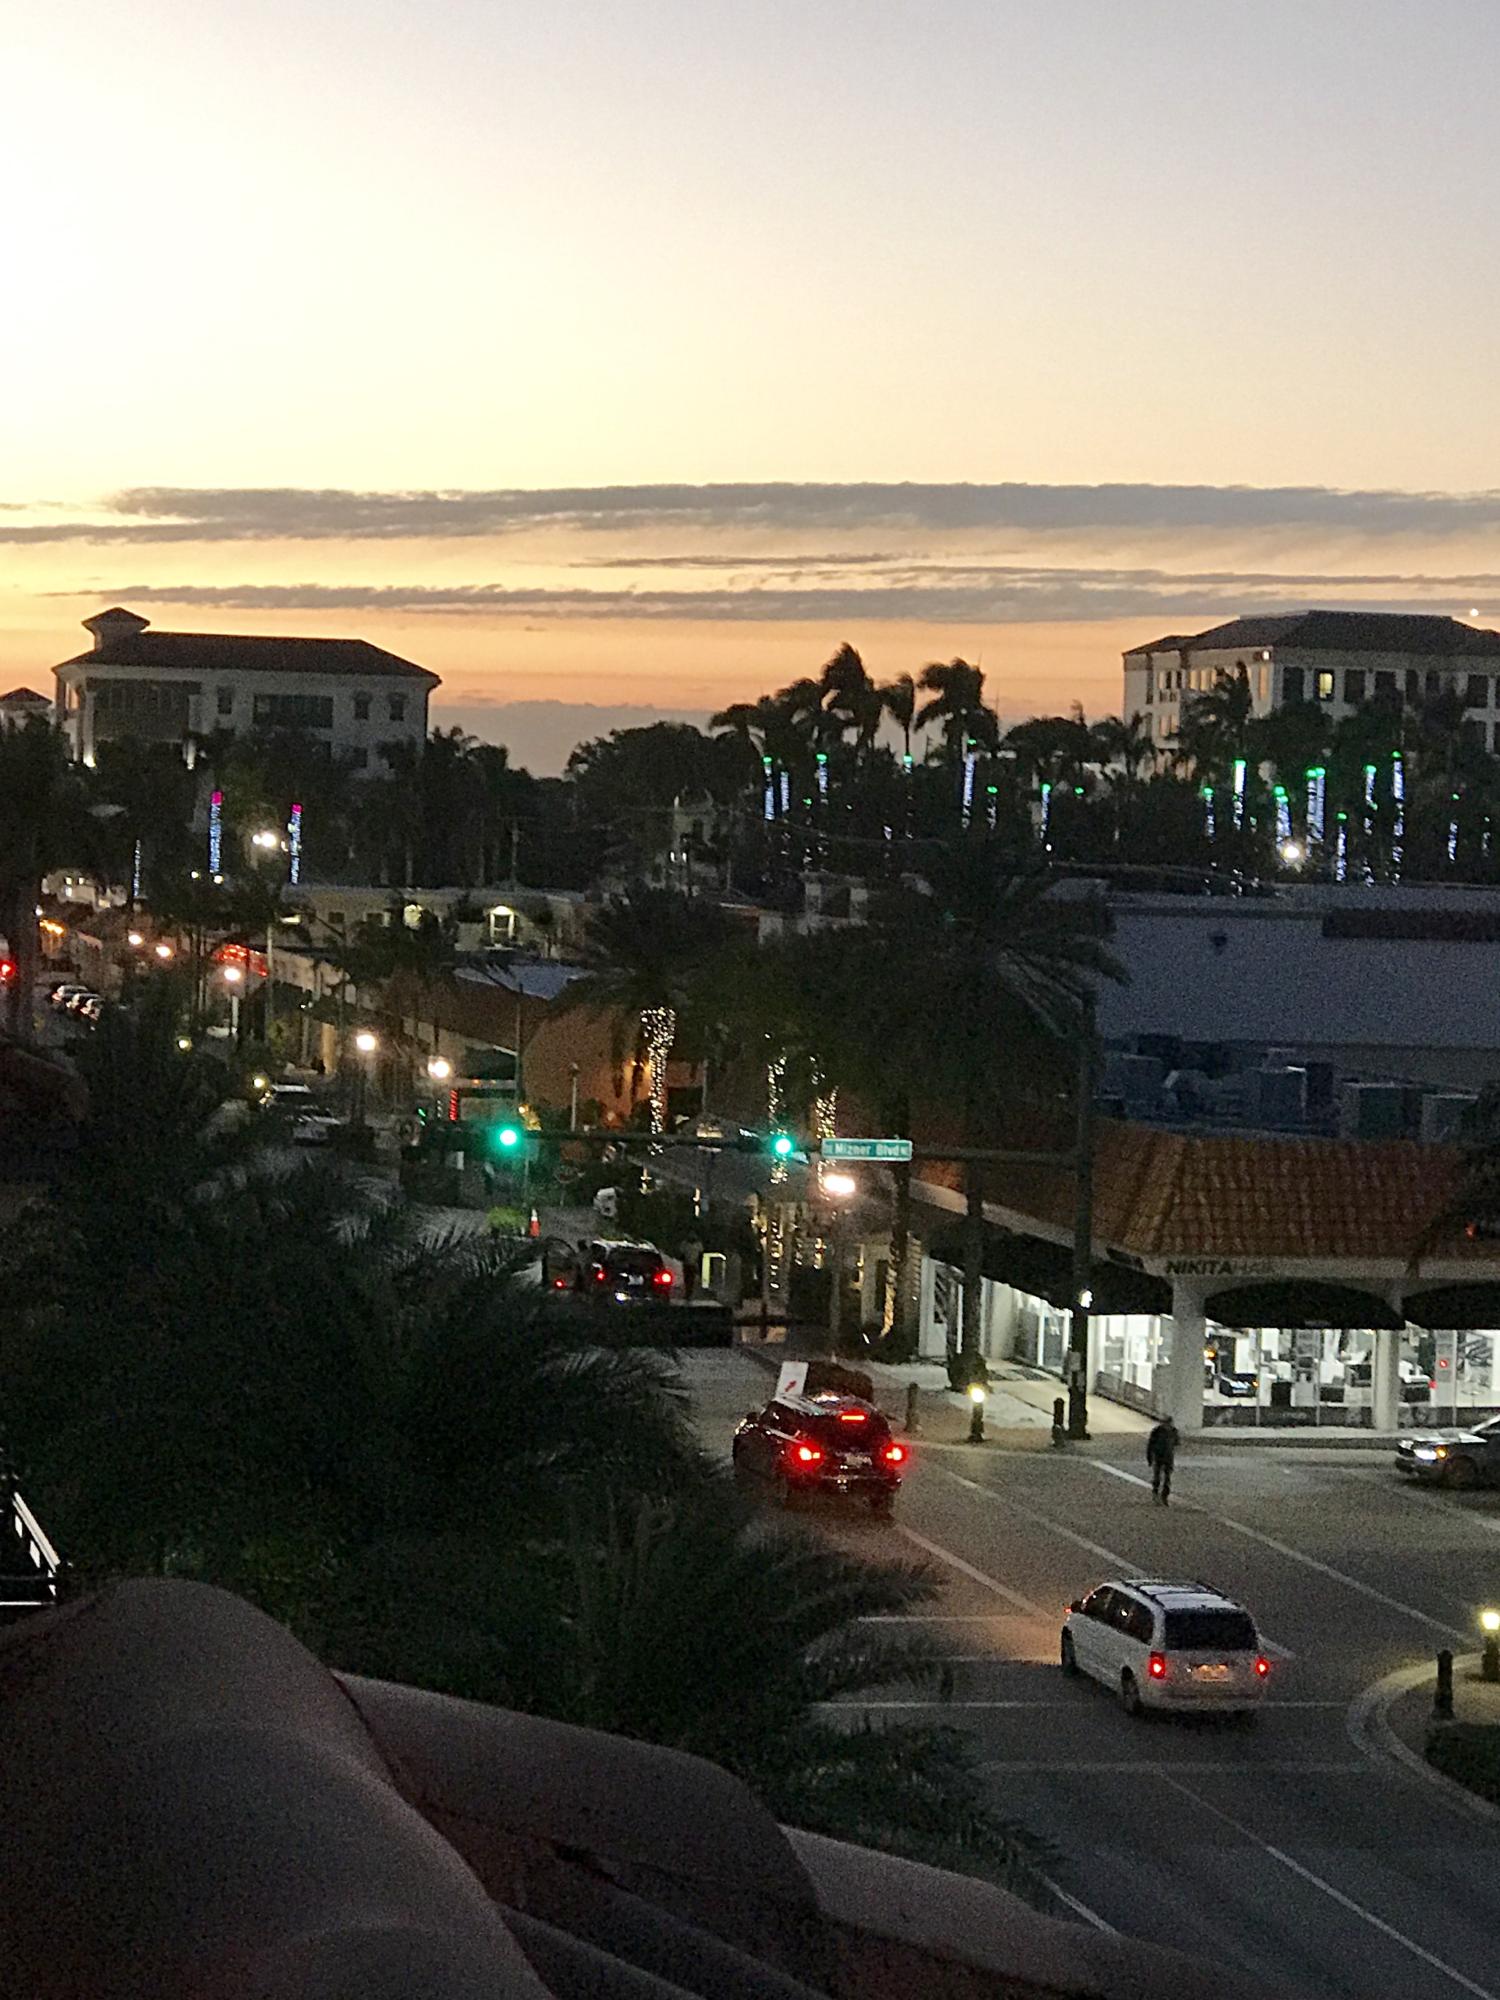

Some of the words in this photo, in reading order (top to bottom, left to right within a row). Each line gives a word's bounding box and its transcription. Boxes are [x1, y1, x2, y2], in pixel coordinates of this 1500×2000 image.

[835, 1142, 872, 1156] Mizner
[876, 1143, 900, 1157] Blvd
[1166, 1260, 1232, 1275] NIKITA
